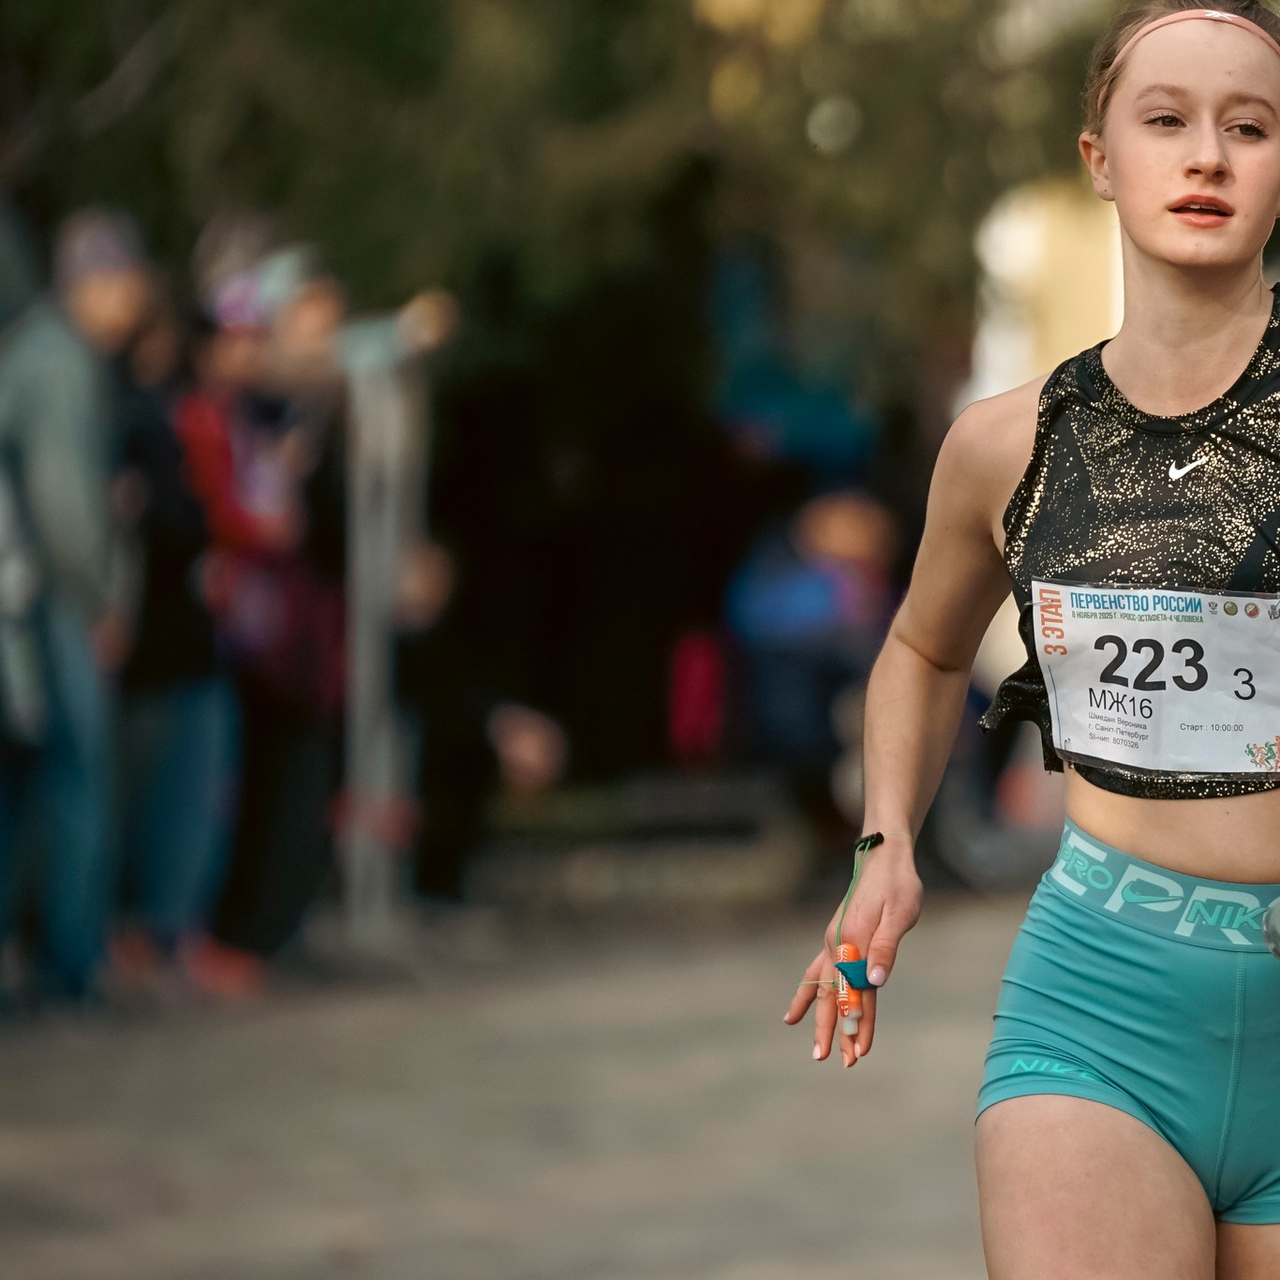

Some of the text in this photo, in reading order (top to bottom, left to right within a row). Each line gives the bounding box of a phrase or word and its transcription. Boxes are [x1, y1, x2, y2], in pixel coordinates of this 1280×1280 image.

[1070, 592, 1203, 613] ПЕРВЕНСТВО РОССИИ
[1039, 589, 1067, 655] 3 ЭТАП
[1174, 615, 1204, 623] ЧЕЛОВЕКА
[1094, 635, 1208, 691] 223
[1233, 668, 1256, 700] 3
[1089, 687, 1153, 719] МЖ16
[1095, 723, 1149, 741] Санкт-Петербург
[1117, 717, 1147, 730] Вероника
[1180, 722, 1203, 732] Старт
[1211, 724, 1244, 732] 10:00:00
[1103, 863, 1260, 946] PR
[1185, 900, 1268, 930] NIK
